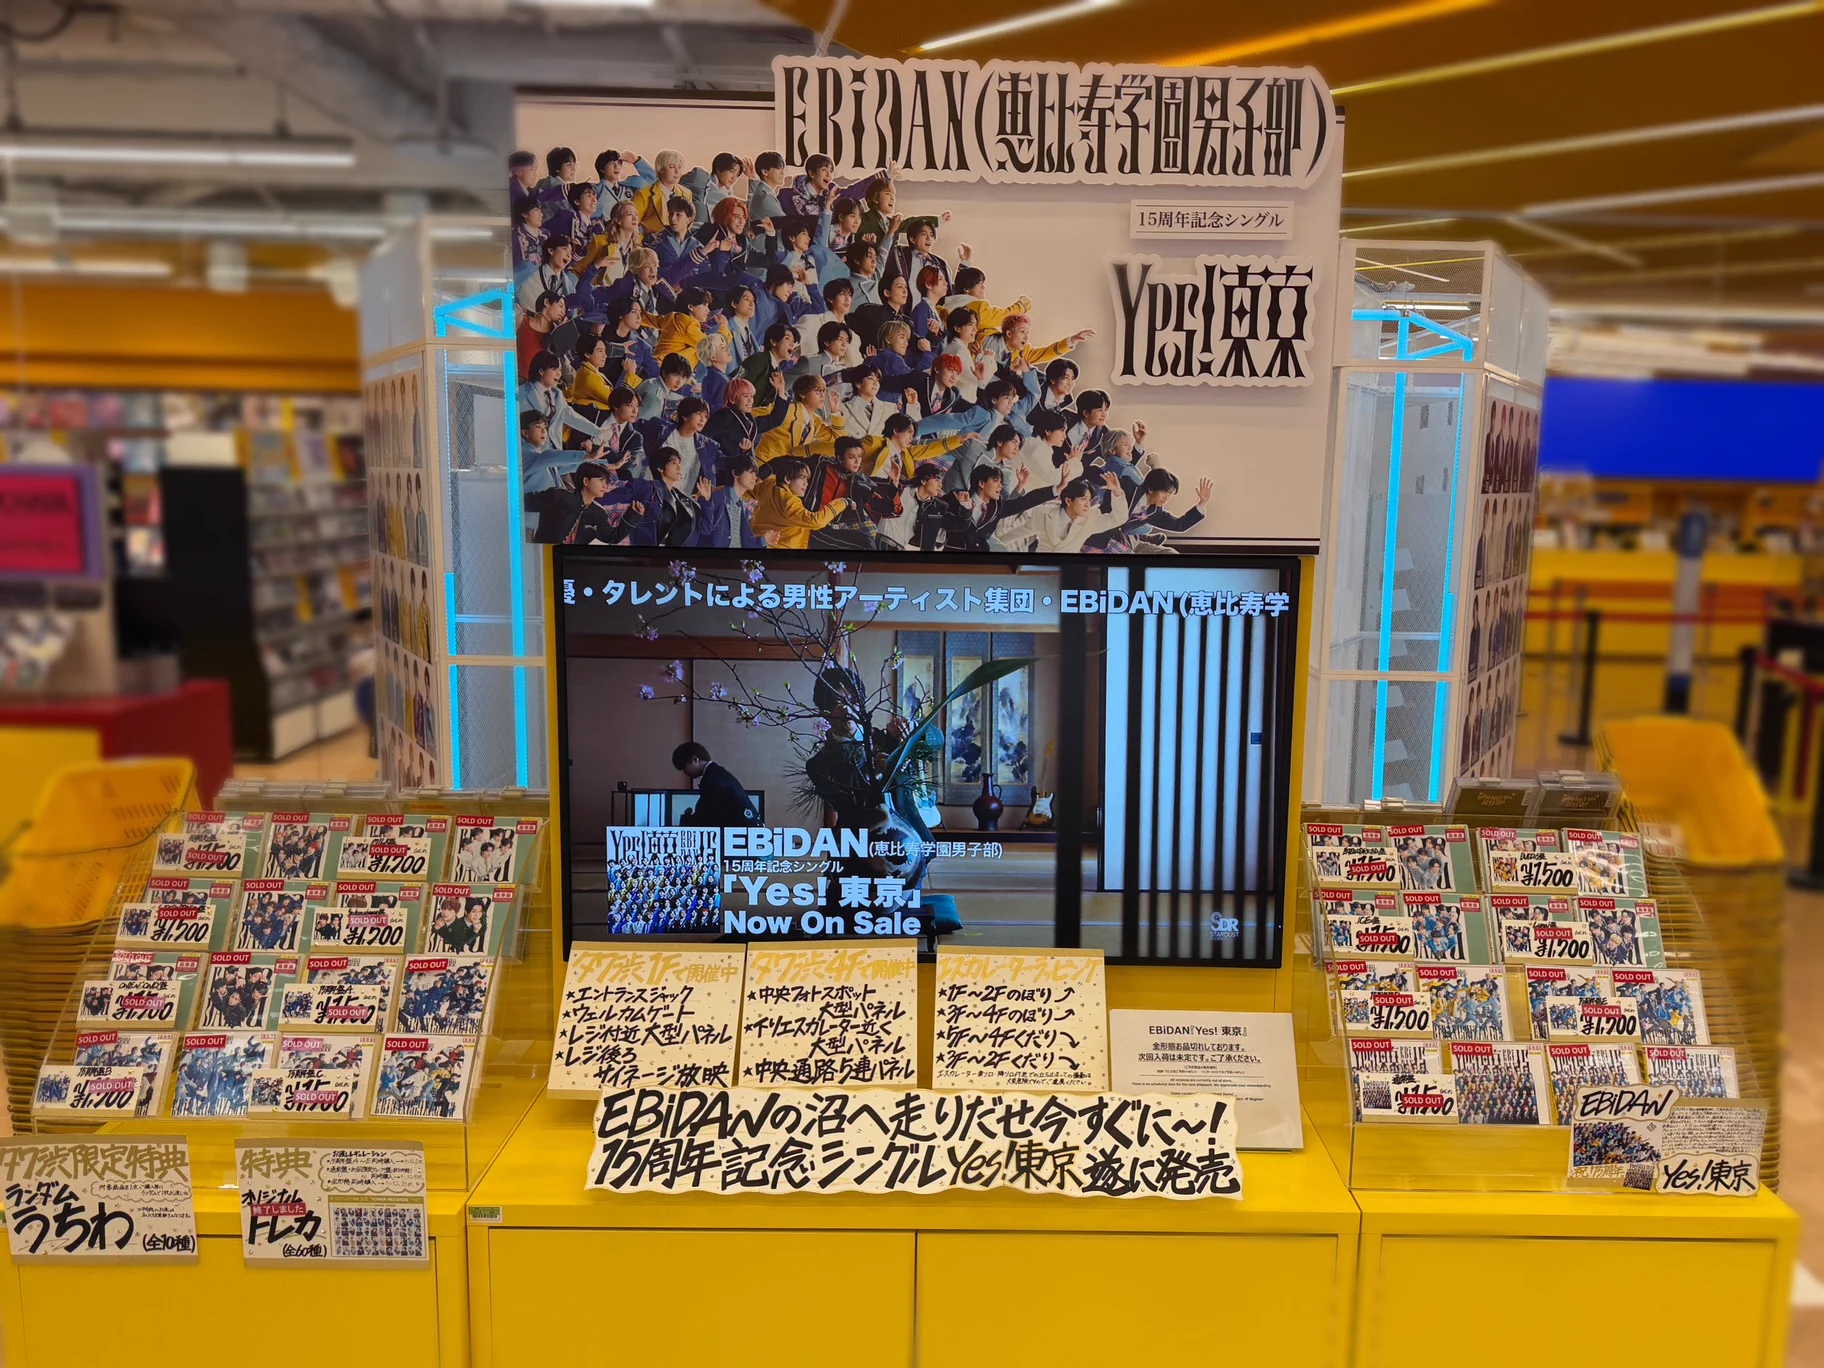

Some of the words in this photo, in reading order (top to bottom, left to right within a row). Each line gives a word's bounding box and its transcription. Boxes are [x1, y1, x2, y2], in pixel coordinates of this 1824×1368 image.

[782, 66, 1327, 177] EBiDAN(恵比寿学園男子部)
[1138, 209, 1285, 230] 15周年記念シングル
[457, 816, 475, 824] SOLD
[1389, 827, 1407, 835] SOLD
[187, 851, 206, 860] SOLD
[207, 853, 223, 861] OUT
[723, 860, 843, 874] 15周年記念シングル
[1520, 862, 1573, 887] ¥1,500
[246, 881, 264, 889] SOLD
[434, 886, 452, 894] SOLD
[453, 887, 470, 895] OUT
[838, 876, 922, 909] 東京」
[1579, 899, 1597, 907] SOLD
[725, 911, 792, 934] Now
[801, 911, 845, 934] On
[853, 911, 922, 935] Sale
[1210, 911, 1239, 932] SDR
[114, 953, 134, 961] SOLD
[135, 953, 152, 962] OUT
[212, 954, 231, 962] SOLD
[232, 954, 249, 962] OUT
[309, 960, 329, 968] SOLD
[409, 961, 429, 970] SOLD
[431, 960, 447, 968] OUT
[938, 957, 1103, 983] エスカレーターラッピング
[1635, 973, 1652, 981] OUT
[573, 985, 695, 1003] エントランスジャック
[759, 984, 877, 1003] 中央フォトスポット
[146, 999, 164, 1007] OUT
[328, 1008, 348, 1016] SOLD
[572, 1003, 696, 1022] ウェルカムゲート
[818, 1001, 906, 1021] 大型パネル
[78, 1035, 98, 1044] SOLD
[100, 1033, 116, 1042] OUT
[185, 1037, 205, 1046] SOLD
[207, 1036, 225, 1045] OUT
[282, 1040, 303, 1048] SOLD
[386, 1040, 407, 1049] SOLD
[409, 1040, 426, 1049] OUT
[808, 1036, 906, 1058] 大型パネル
[1152, 1041, 1246, 1052] 全形態お品切れしております。
[1353, 1041, 1372, 1049] SOLD
[1551, 1047, 1569, 1055] SOLD
[565, 1044, 638, 1066] レジ後ろ
[1138, 1053, 1262, 1063] 次回入荷は未定です。ご了承ください。
[593, 1065, 730, 1089] サイネージ放映
[755, 1057, 916, 1087] 中央通路5連パネル
[91, 1082, 112, 1091] SOLD
[115, 1081, 132, 1089] OUT
[295, 1093, 317, 1101] SOLD
[318, 1093, 336, 1101] OUT
[1580, 1089, 1674, 1117] EBiDAN
[239, 1146, 313, 1180] 特典
[5, 1180, 80, 1207] ランダム
[241, 1188, 304, 1206] オリジナル
[252, 1205, 304, 1216] 終了しました
[12, 1201, 135, 1254] うちわ
[248, 1209, 322, 1245] トレカ
[142, 1233, 196, 1253] (全10種)
[282, 1243, 328, 1259] (全60種)
